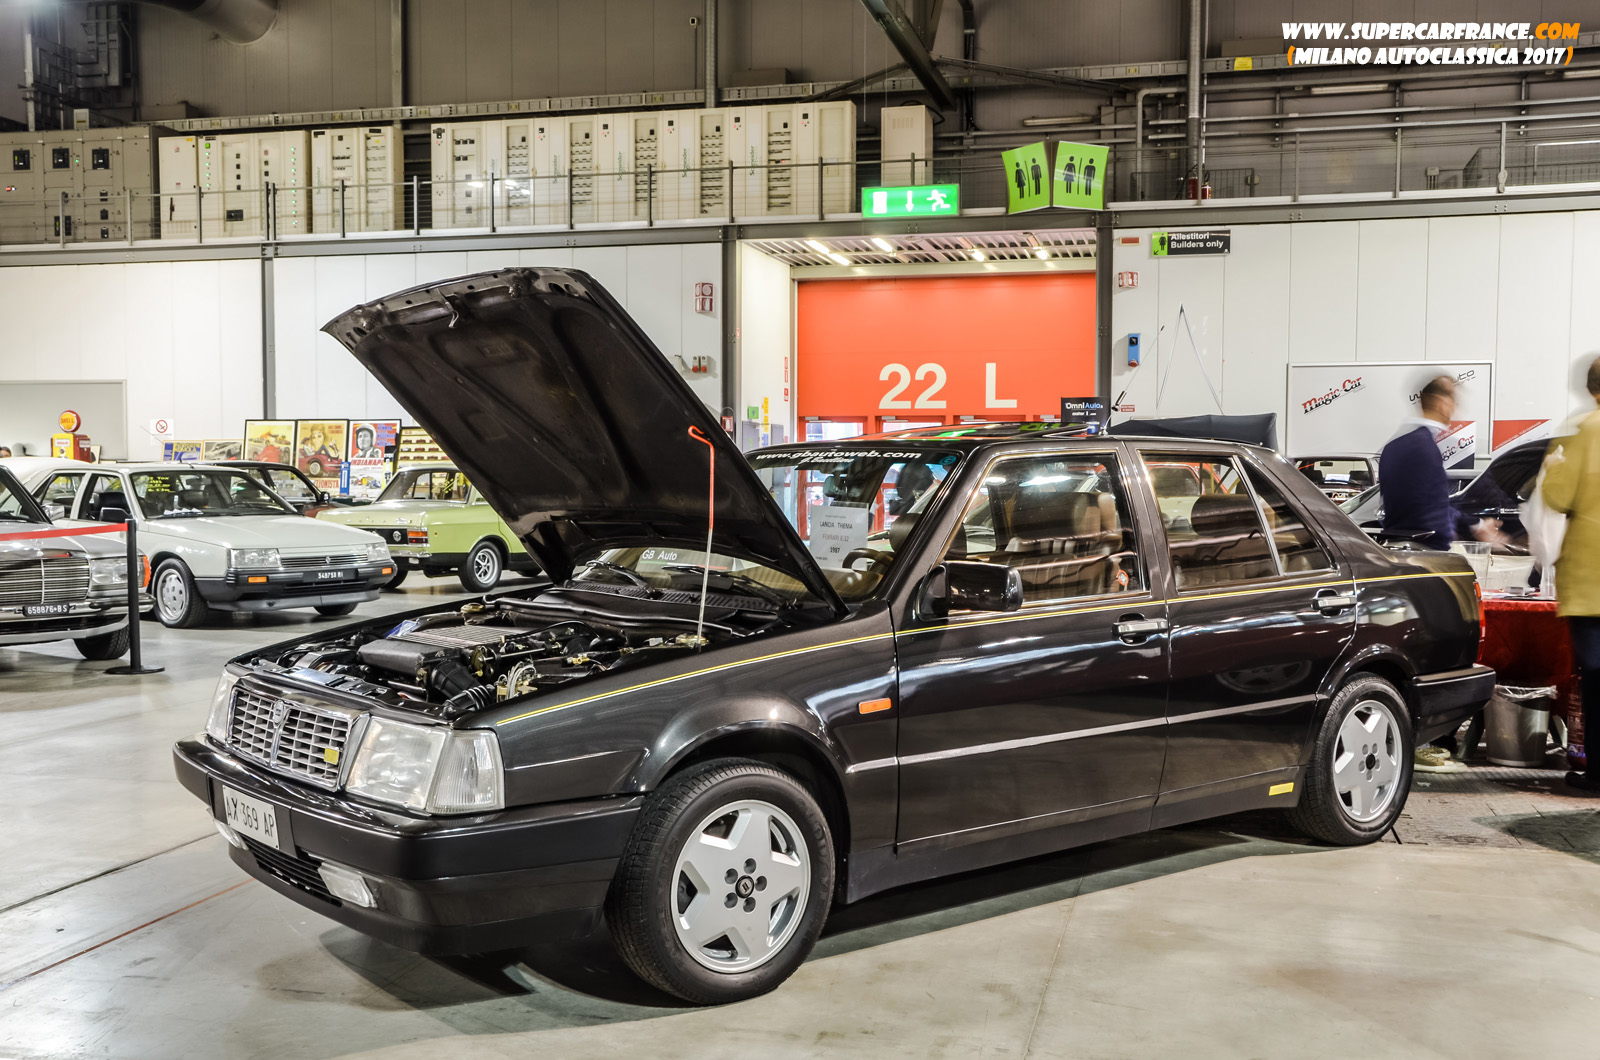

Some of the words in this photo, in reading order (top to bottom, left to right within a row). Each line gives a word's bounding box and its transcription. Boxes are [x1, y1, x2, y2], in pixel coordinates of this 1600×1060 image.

[1170, 232, 1209, 241] Allestitori
[1170, 240, 1204, 249] Builders
[1205, 240, 1224, 249] only
[879, 362, 947, 410] 22
[985, 362, 1017, 409] L
[756, 450, 922, 460] www.gbautoweb.com
[838, 522, 853, 530] THEMA
[642, 550, 655, 559] GB
[657, 550, 678, 561] Auto
[226, 796, 239, 822] AX
[240, 802, 259, 831] 369
[263, 811, 275, 837] AP
